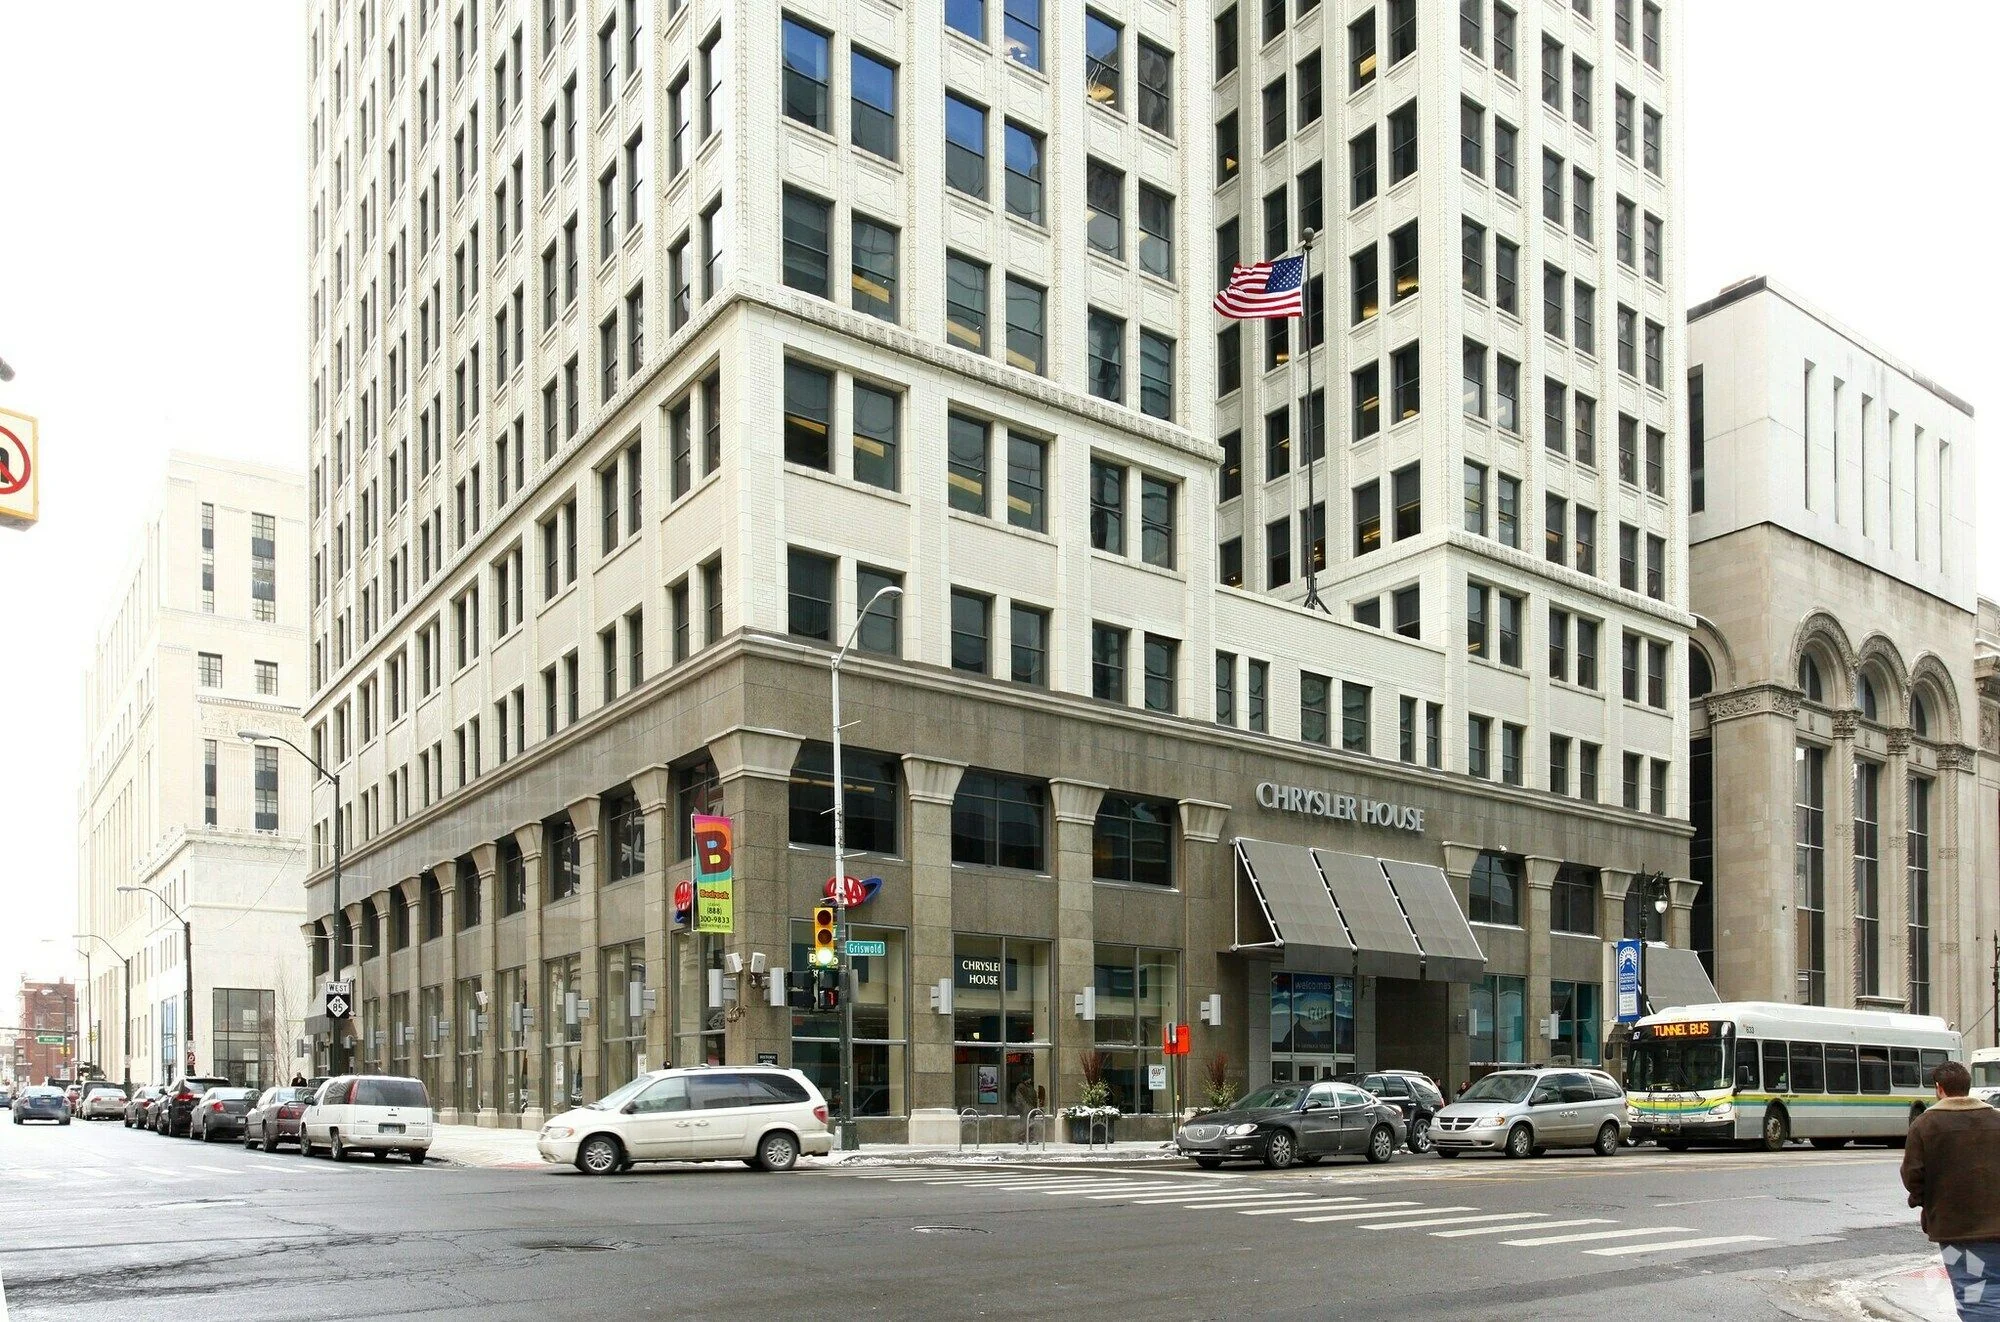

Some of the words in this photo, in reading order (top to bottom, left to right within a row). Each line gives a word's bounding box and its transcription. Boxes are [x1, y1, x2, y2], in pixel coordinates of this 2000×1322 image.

[1255, 782, 1358, 822] CHRYSLER
[1360, 799, 1426, 832] HOUSE
[694, 830, 732, 875] B
[699, 889, 730, 900] Bedrock
[848, 943, 882, 954] Griswold
[969, 974, 998, 985] HOUSE
[329, 983, 348, 992] WEST
[332, 1003, 344, 1013] 85
[1653, 1023, 1686, 1037] TUNNEL
[1689, 1022, 1709, 1035] BUS
